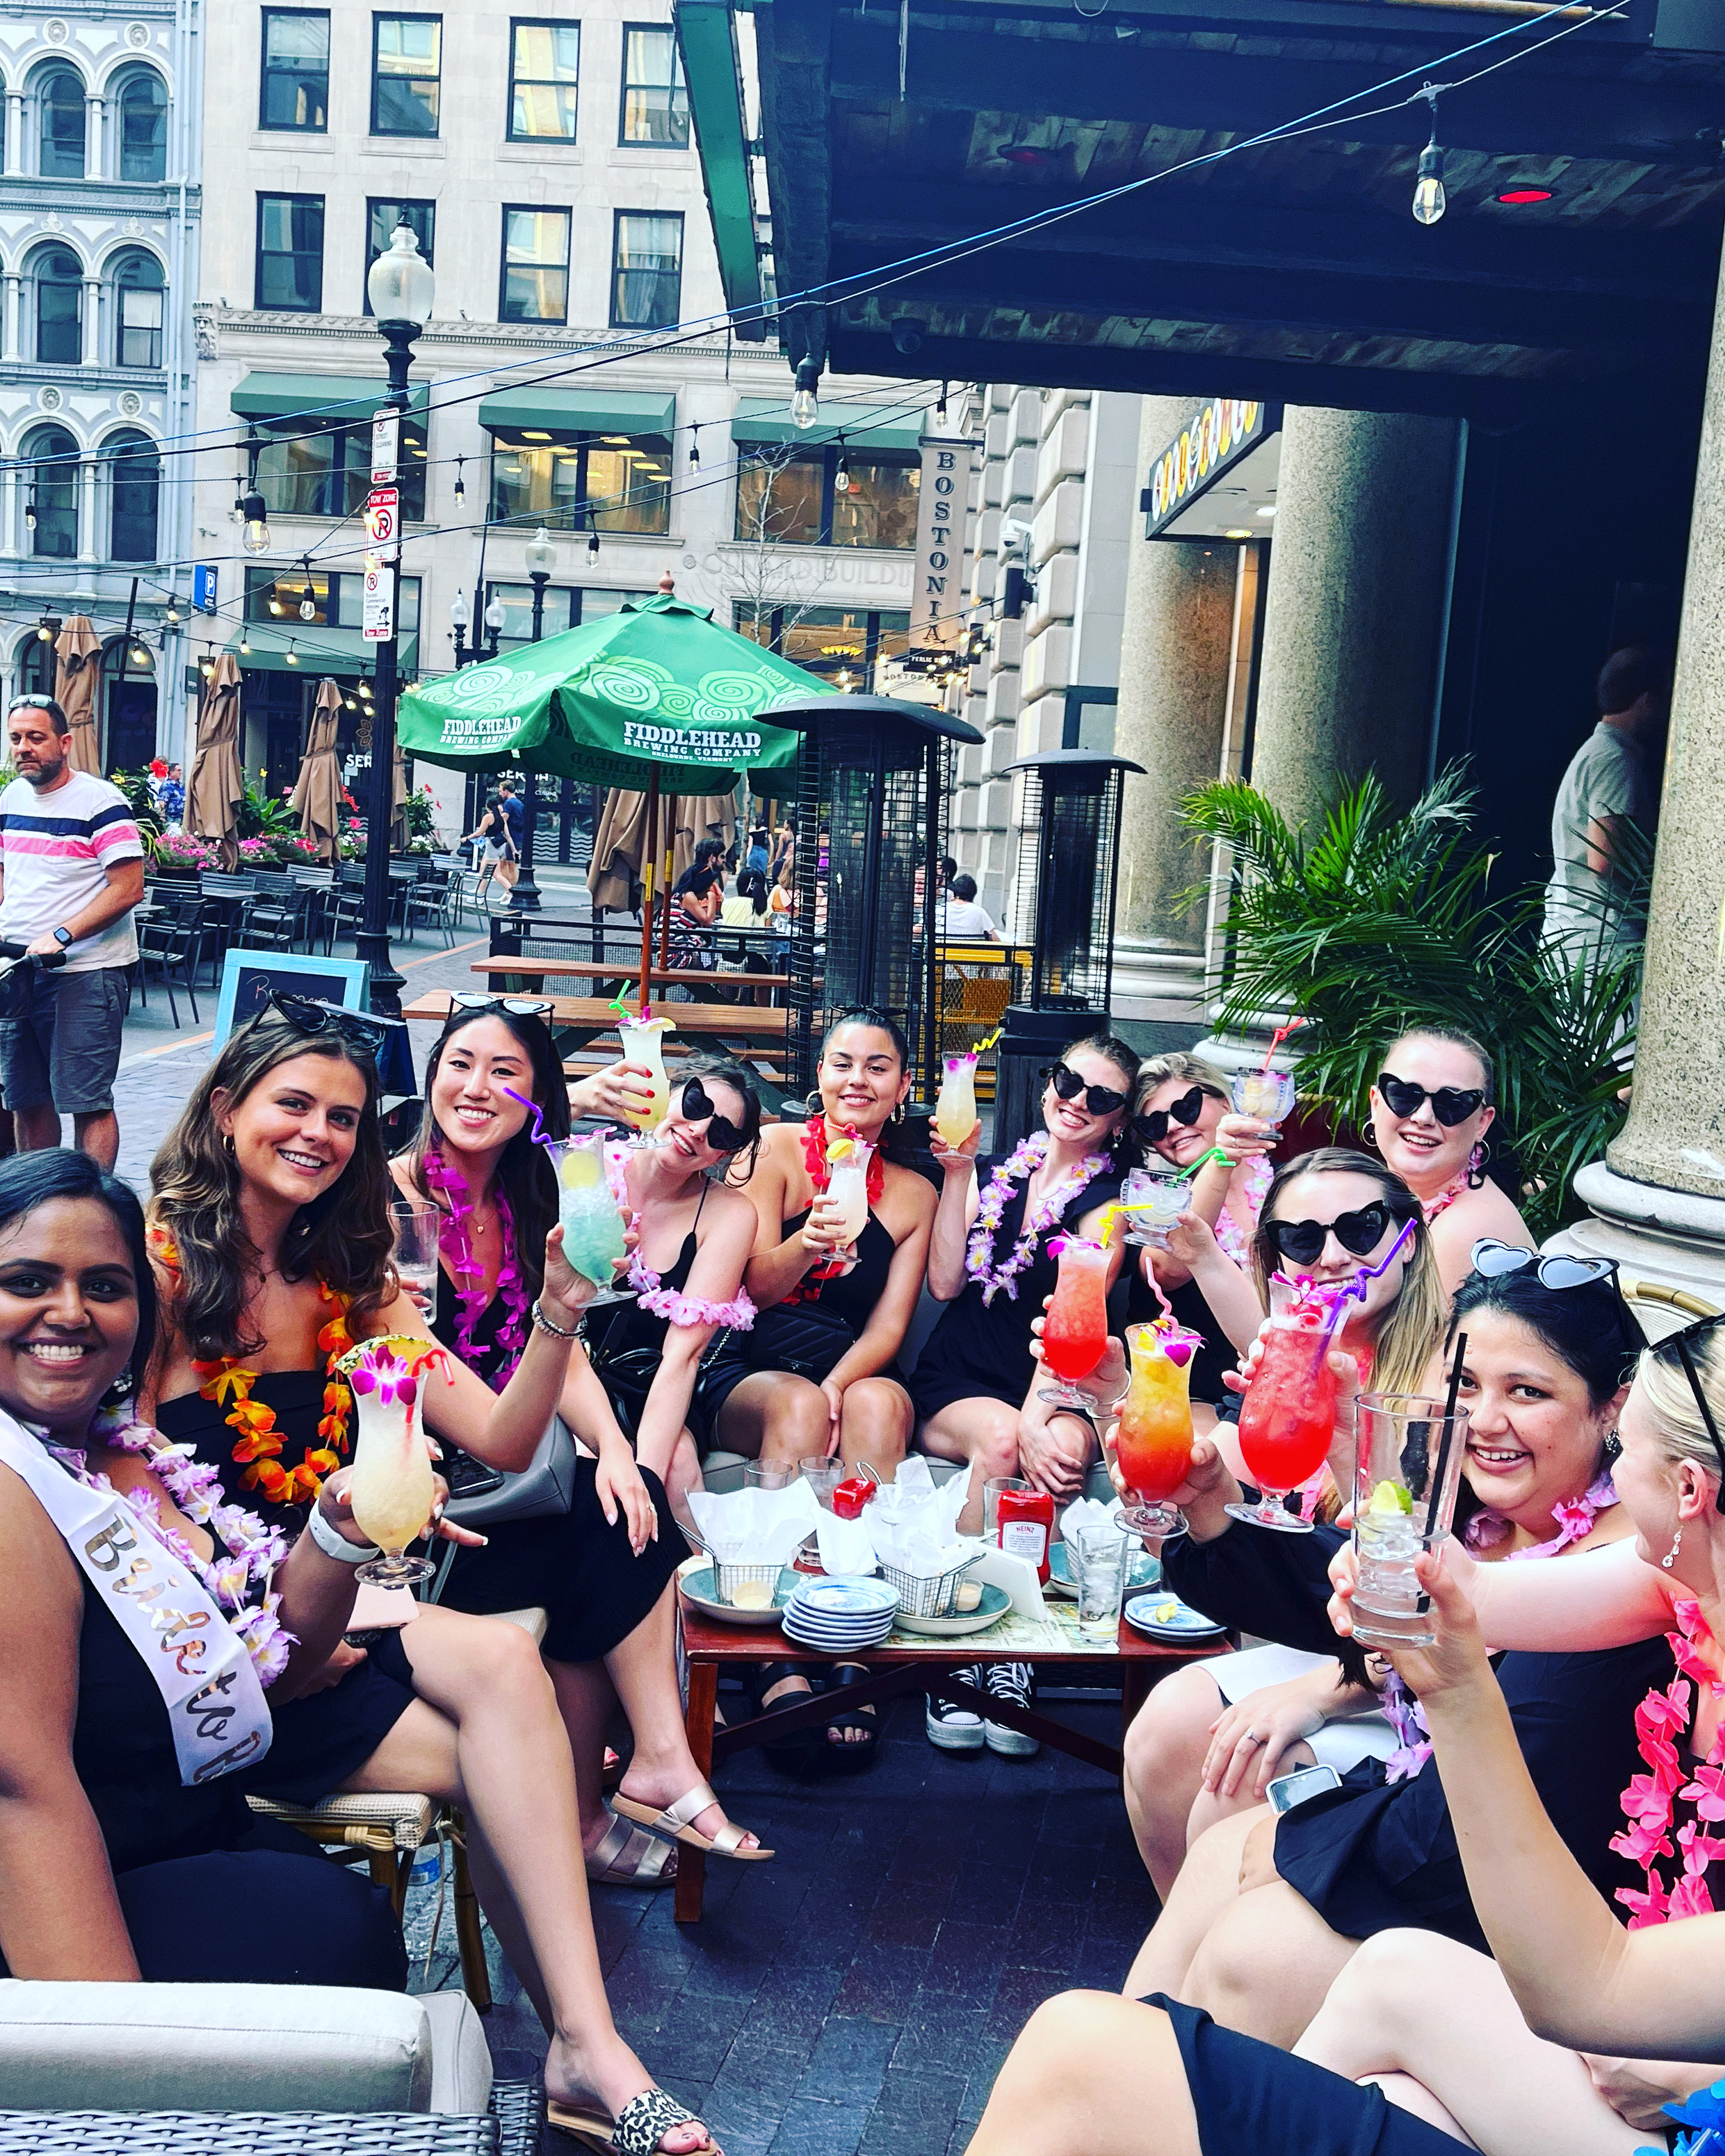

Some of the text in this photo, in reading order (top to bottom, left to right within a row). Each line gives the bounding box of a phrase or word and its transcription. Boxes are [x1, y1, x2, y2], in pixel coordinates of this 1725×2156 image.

[371, 493, 396, 504] TOW ZONE
[922, 451, 956, 643] BOSTONIA
[443, 716, 522, 735] FIDDLEHEAD
[624, 721, 762, 748] FIDDLEHEAD
[440, 735, 479, 745] BREWING
[623, 737, 762, 757] BREWING COMPANY
[84, 1512, 210, 1675] Bride
[186, 1669, 237, 1741] to
